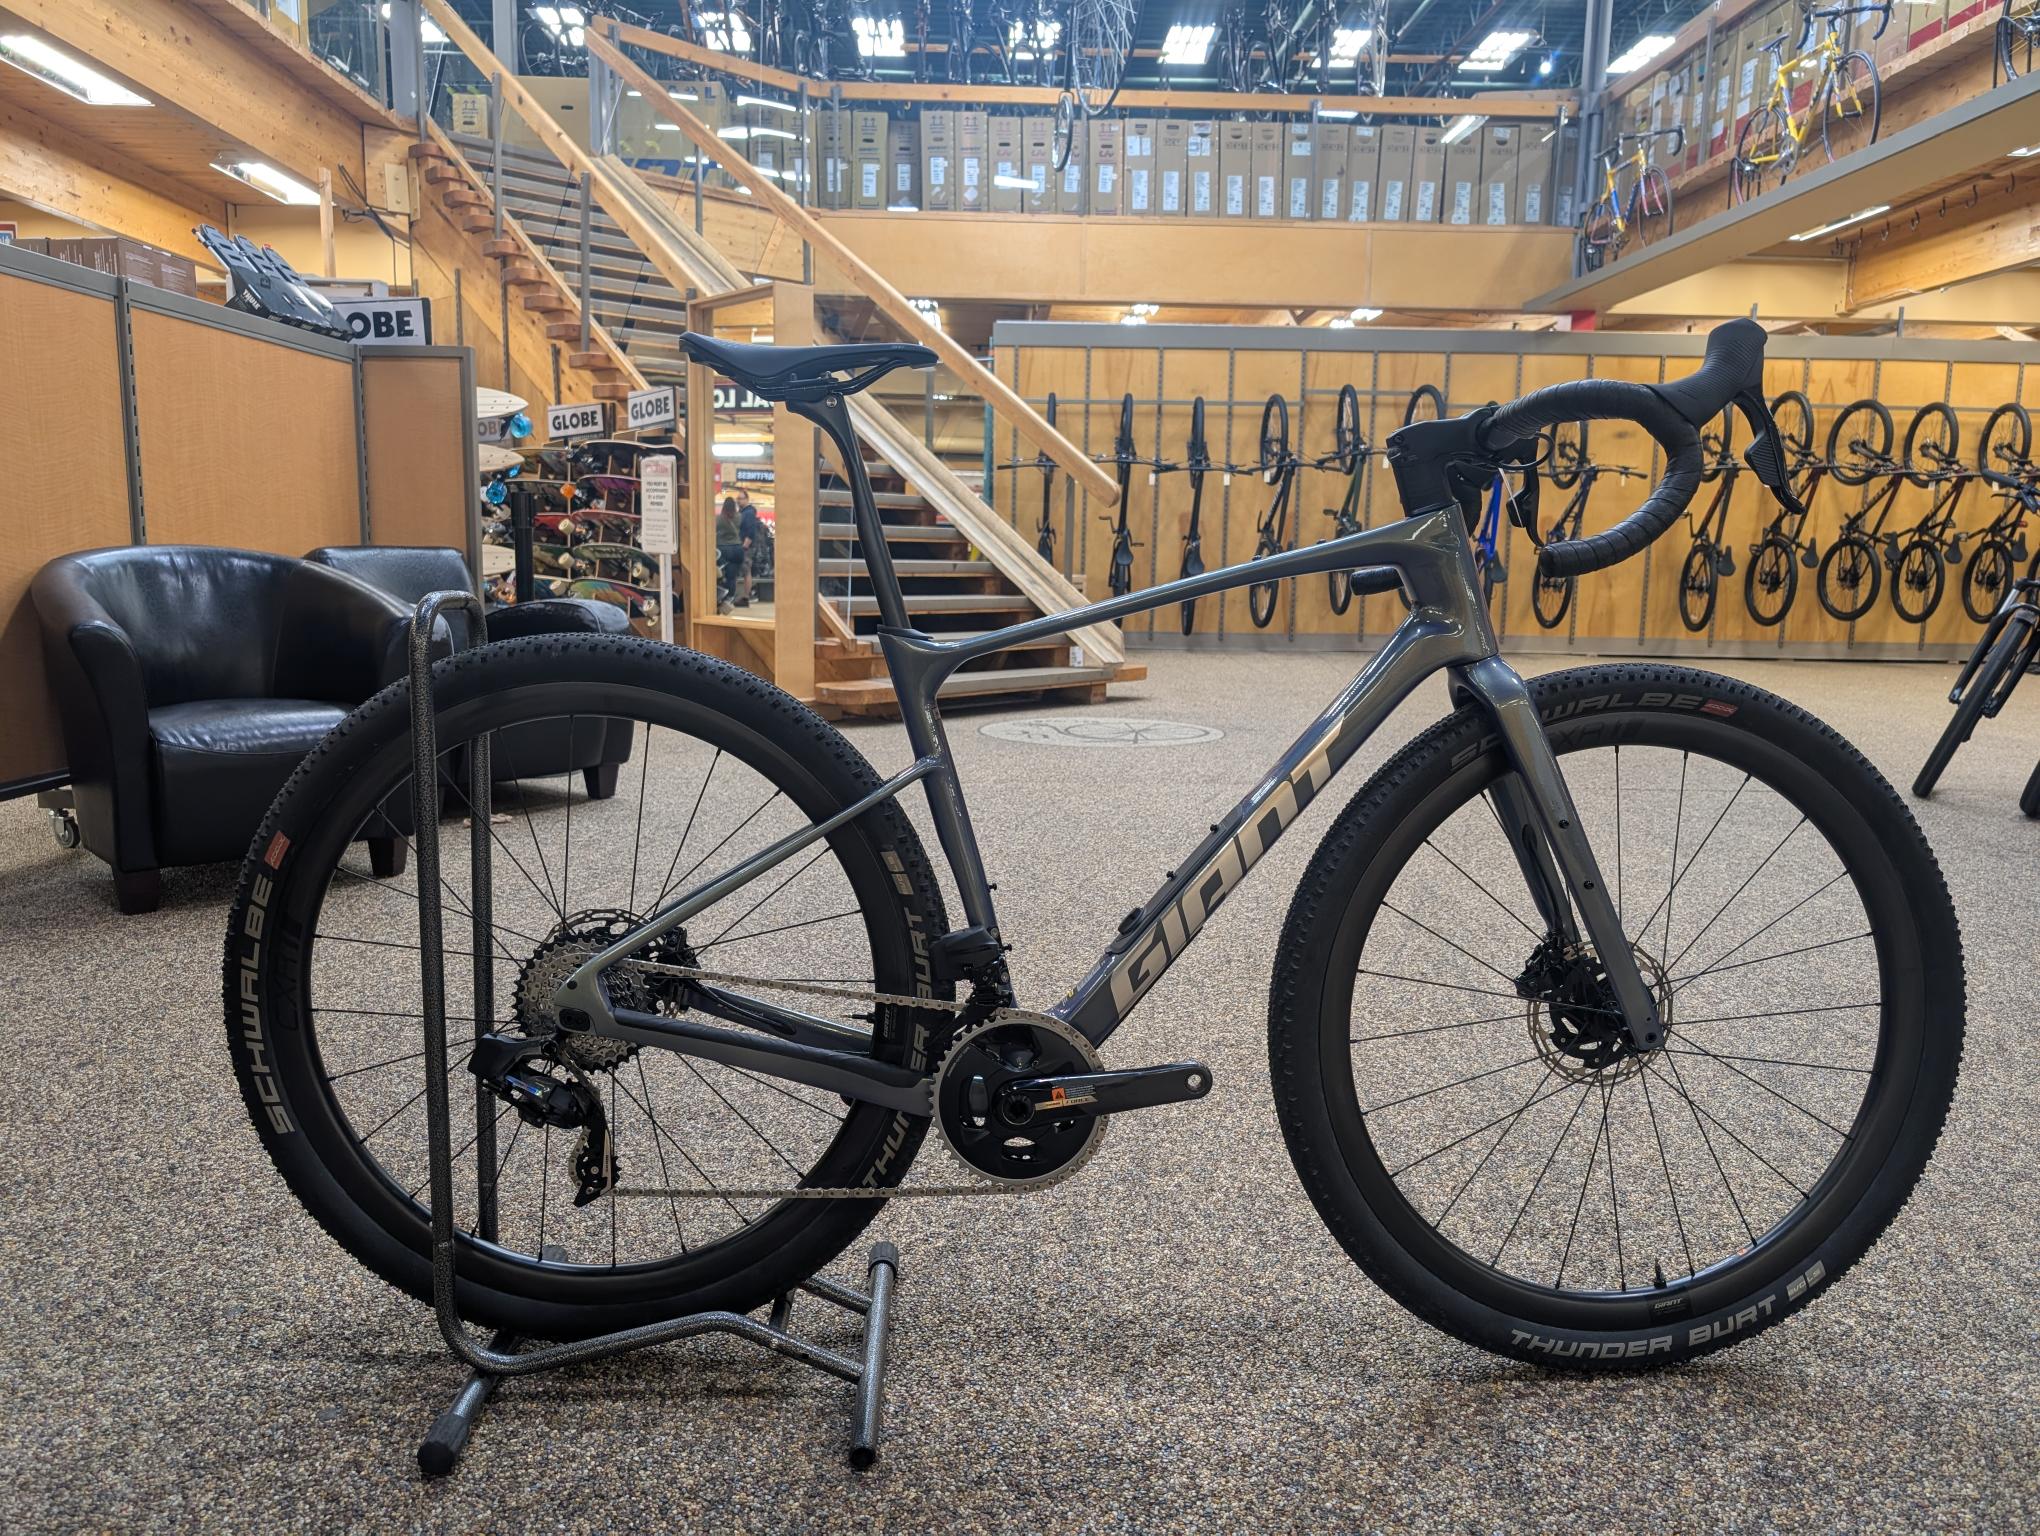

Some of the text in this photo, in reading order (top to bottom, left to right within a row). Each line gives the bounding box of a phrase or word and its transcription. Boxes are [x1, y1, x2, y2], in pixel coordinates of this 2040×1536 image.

[242, 288, 262, 311] THULE
[347, 310, 414, 340] OBE
[552, 410, 599, 431] GLOBE
[632, 396, 671, 421] GLOBE
[1110, 717, 1345, 1014] GIANT
[240, 874, 294, 1135] SCHWALBE
[1511, 1328, 1673, 1359] THUNDER
[1688, 1294, 1777, 1347] BURT
